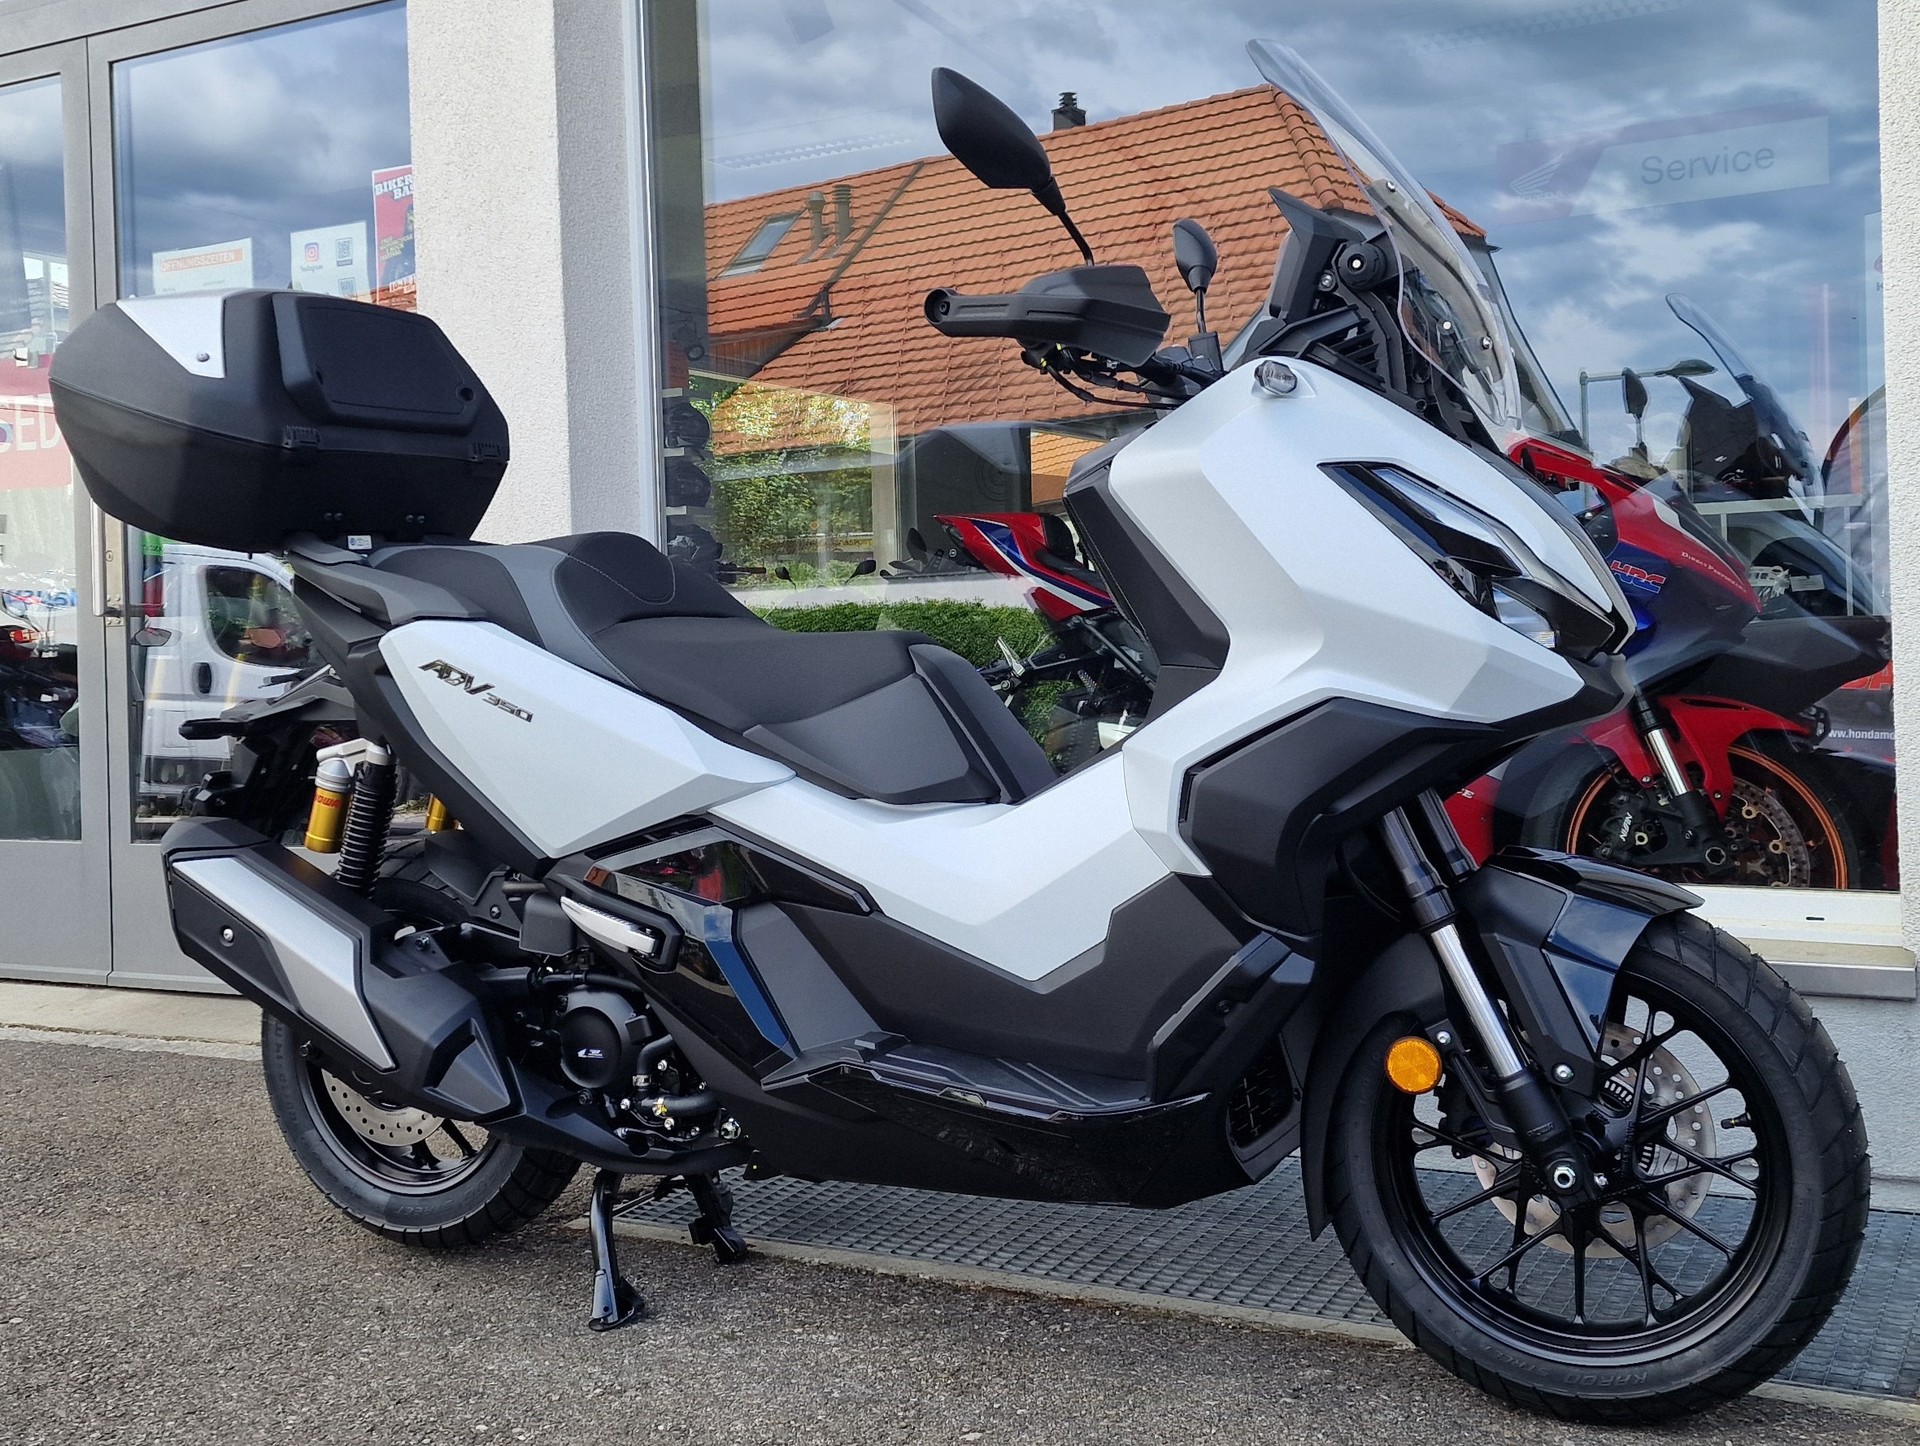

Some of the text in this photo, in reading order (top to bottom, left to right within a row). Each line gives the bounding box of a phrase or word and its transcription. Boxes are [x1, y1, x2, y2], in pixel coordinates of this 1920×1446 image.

[1640, 145, 1776, 185] Service
[1609, 560, 1667, 594] HRC
[417, 659, 534, 723] ADV 350
[1563, 1371, 1649, 1388] KAROO
